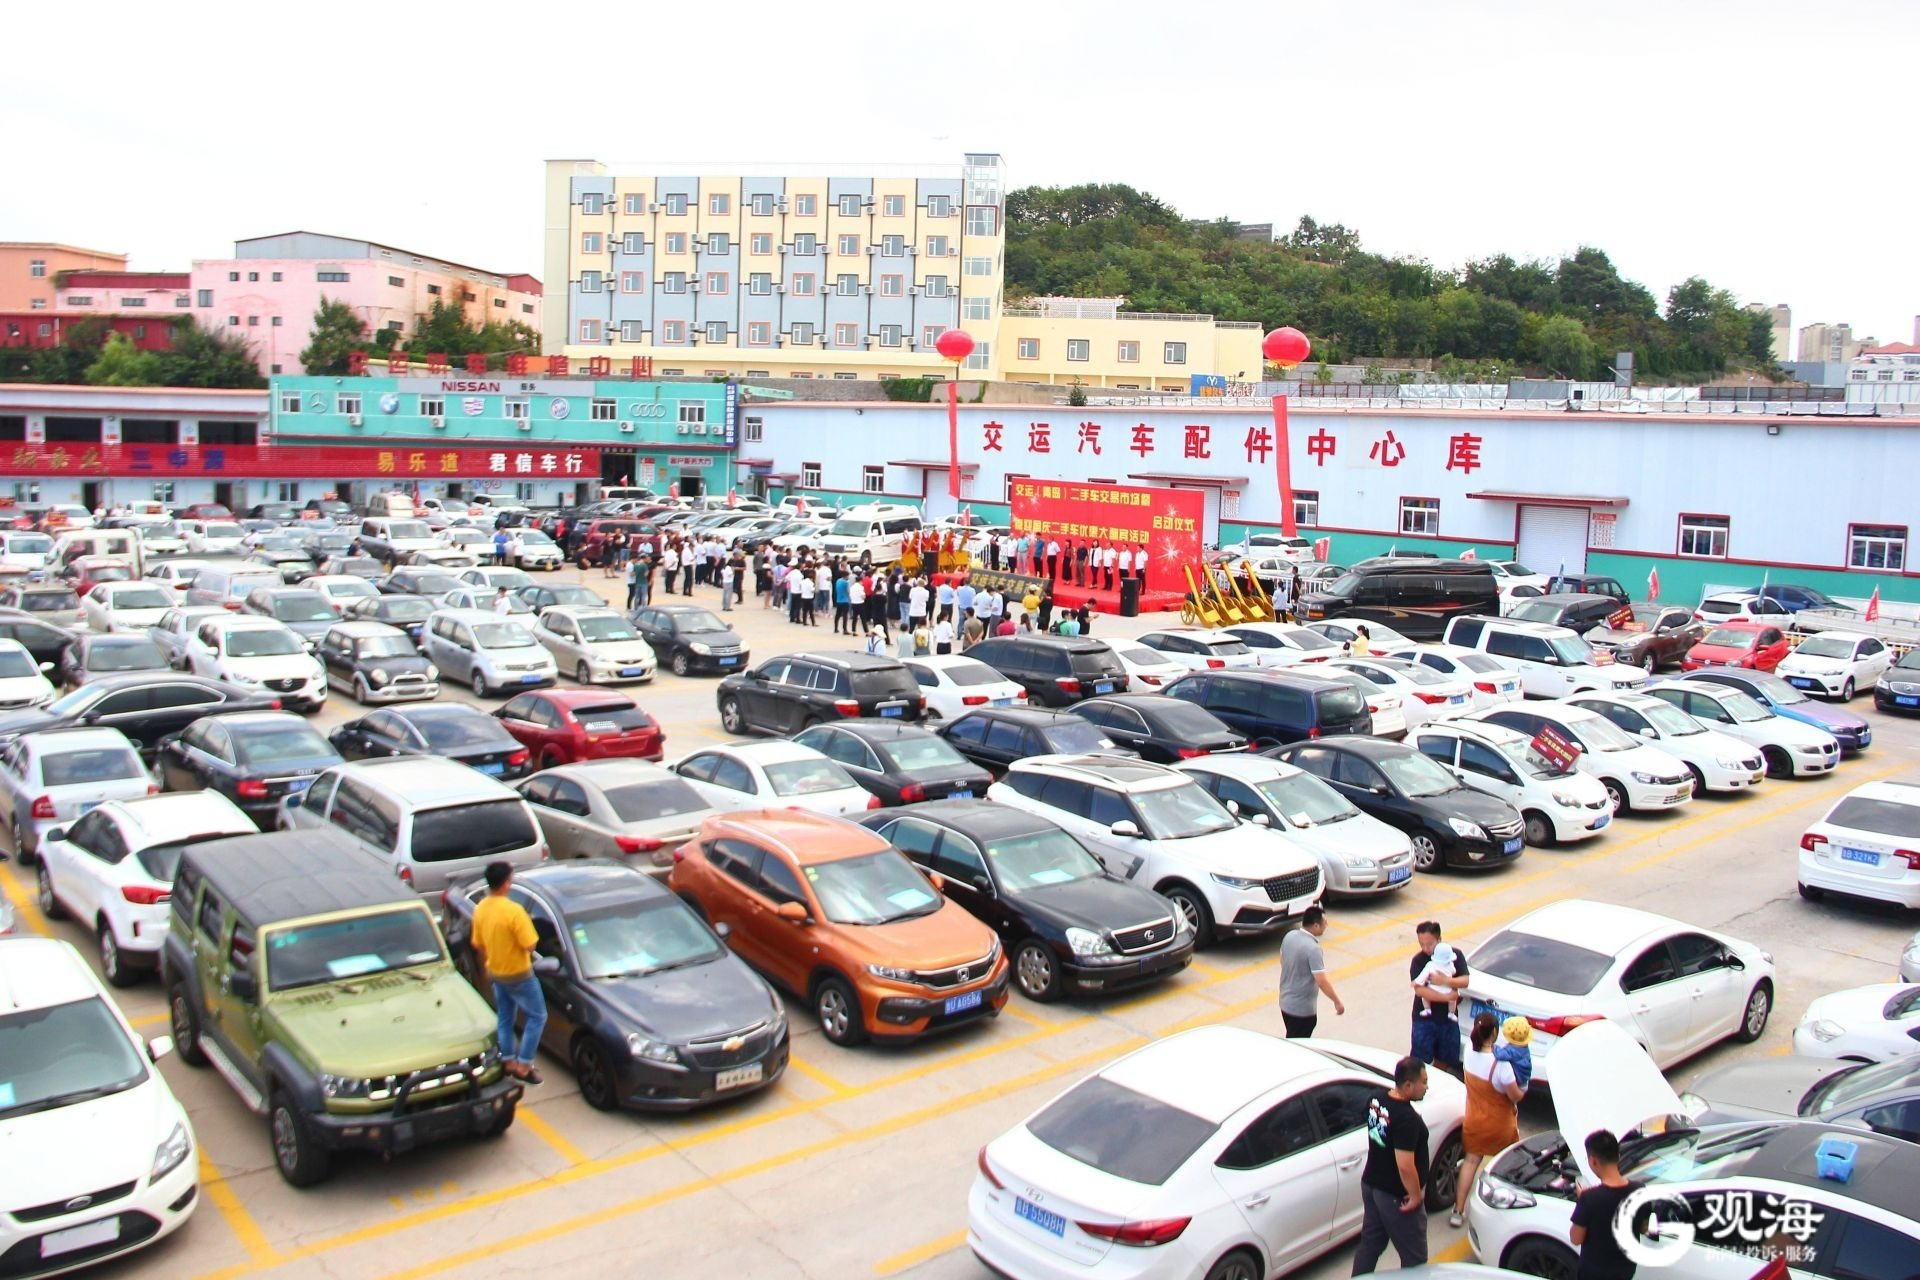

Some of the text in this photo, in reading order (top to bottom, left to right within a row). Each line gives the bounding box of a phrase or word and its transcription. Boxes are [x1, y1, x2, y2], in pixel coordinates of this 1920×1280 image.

[442, 381, 500, 392] NISSAN
[983, 421, 1483, 474] 交运汽车配件中心库
[378, 452, 459, 473] 易乐道
[489, 453, 584, 473] 君信车行
[1153, 515, 1195, 532] 启动仪式
